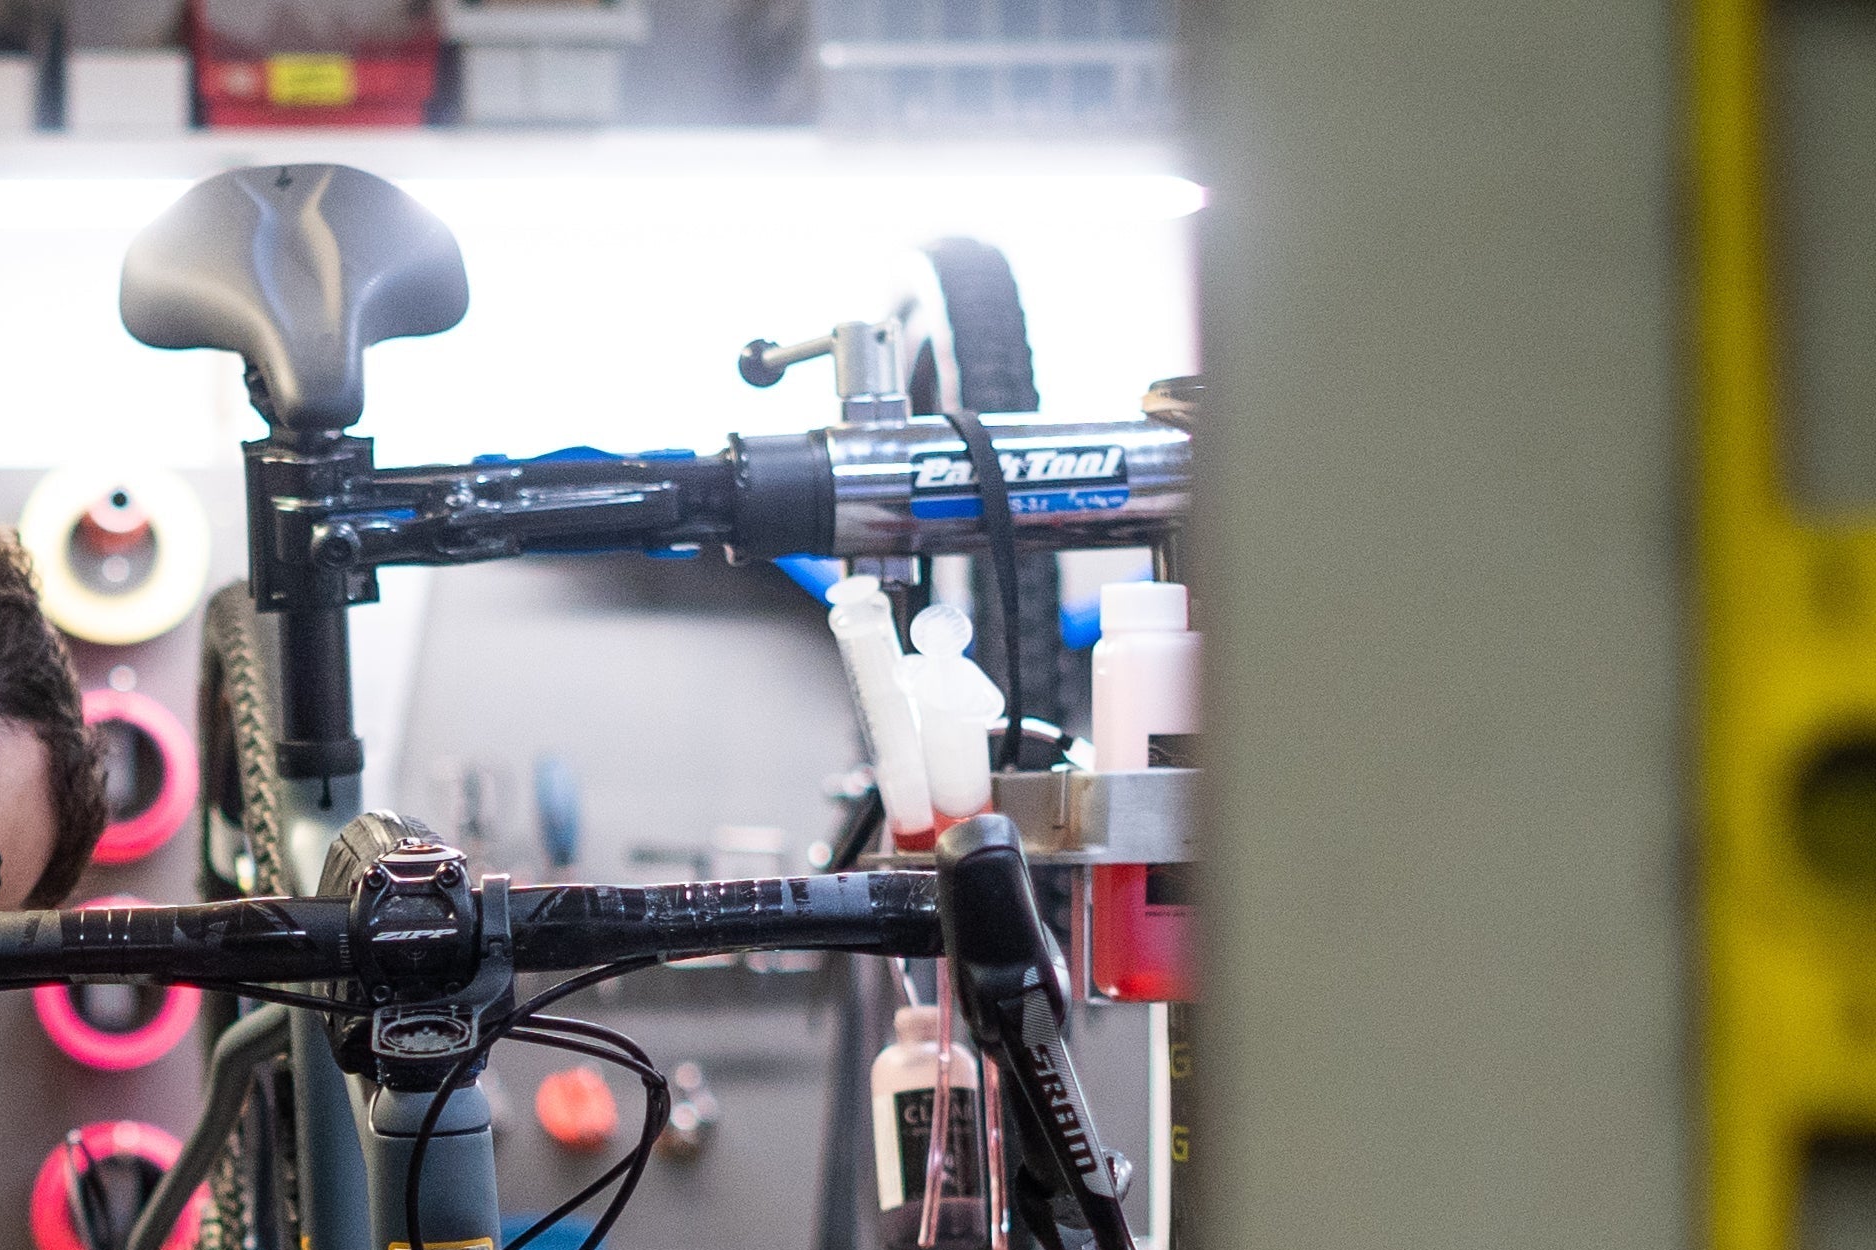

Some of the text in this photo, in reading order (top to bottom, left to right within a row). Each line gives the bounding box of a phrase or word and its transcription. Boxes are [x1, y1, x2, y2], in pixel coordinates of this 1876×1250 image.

[914, 452, 1021, 488] Pak
[371, 929, 458, 941] ZIPP
[1031, 1043, 1098, 1175] SRAM
